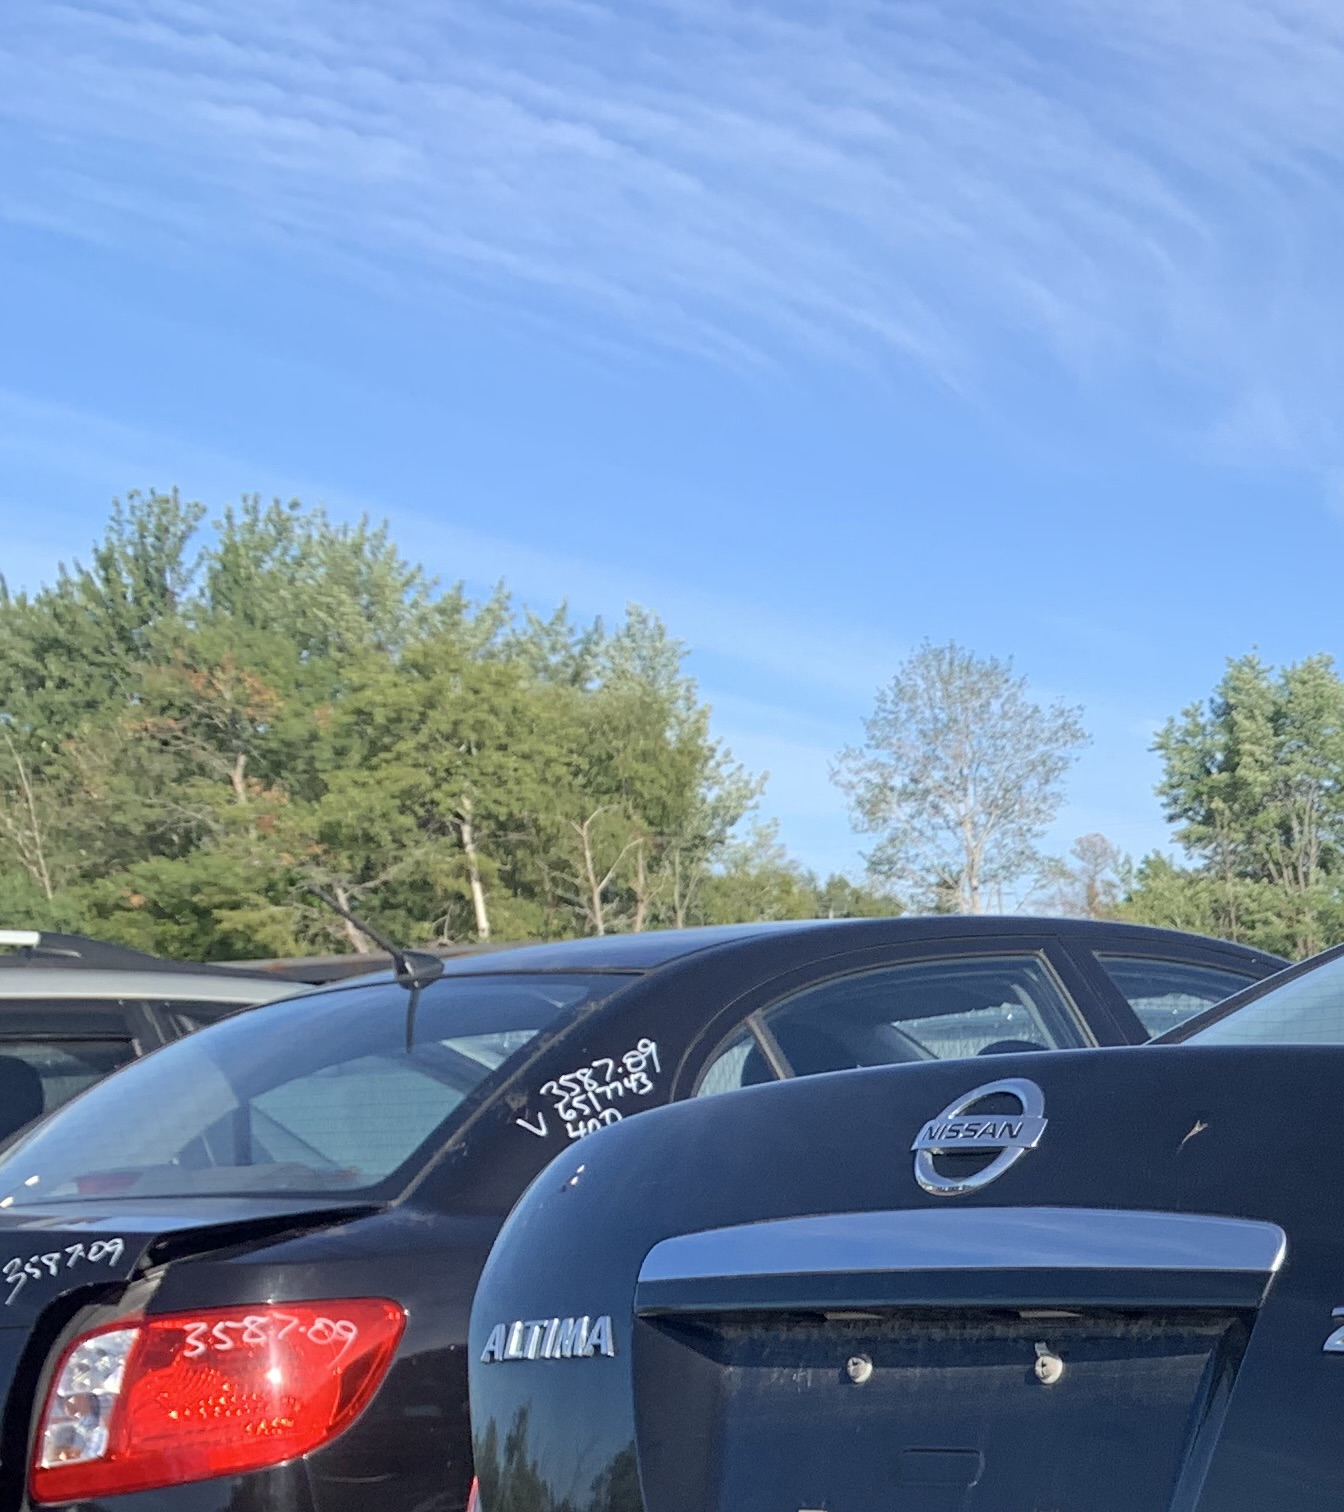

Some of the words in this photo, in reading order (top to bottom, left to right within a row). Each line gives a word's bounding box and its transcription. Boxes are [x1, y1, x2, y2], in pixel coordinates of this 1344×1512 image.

[922, 1121, 1024, 1141] NISSAN
[182, 1311, 358, 1370] 3587.09
[480, 1315, 615, 1364] ALTIMA
